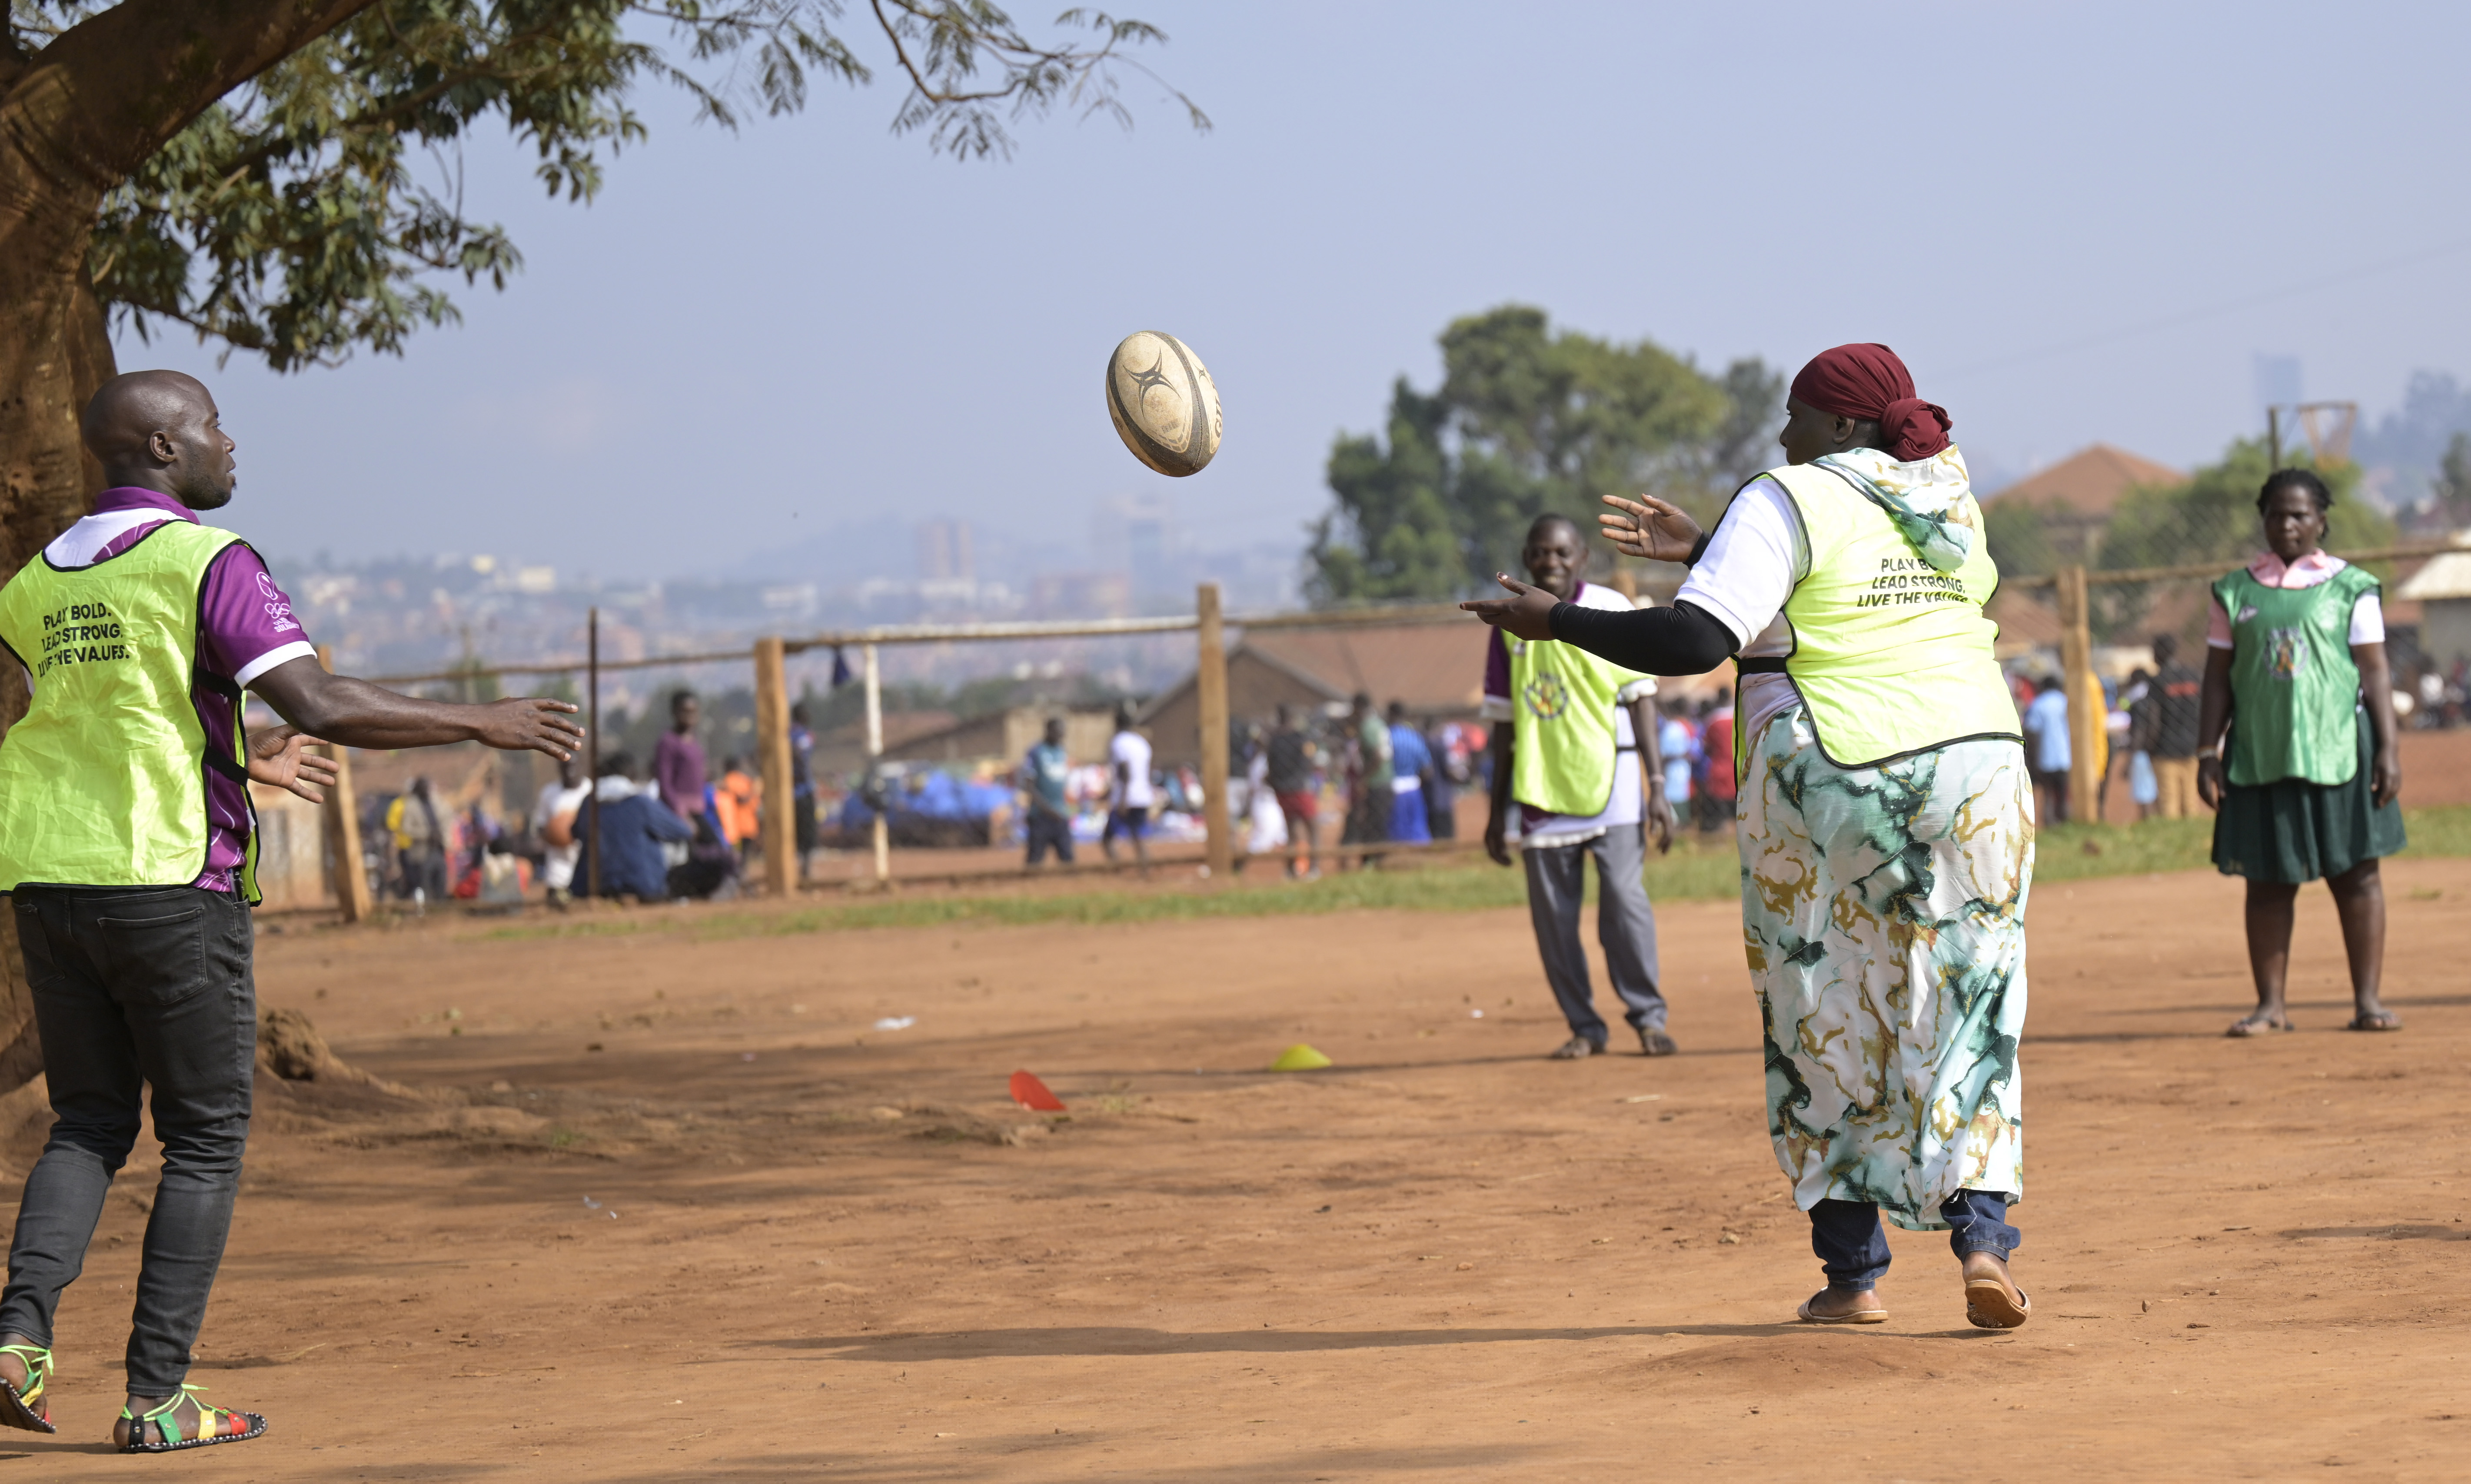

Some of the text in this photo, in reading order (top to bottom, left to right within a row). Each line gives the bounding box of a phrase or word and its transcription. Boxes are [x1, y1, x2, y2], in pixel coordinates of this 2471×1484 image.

[1881, 558, 1915, 572] PLAY
[1872, 575, 1965, 594] LEAD STRONG.
[1857, 594, 1891, 607] LIVE
[1894, 592, 1922, 604] THE
[43, 602, 112, 630] PLAY BOLD.
[41, 623, 123, 653] LEAD STRONG.
